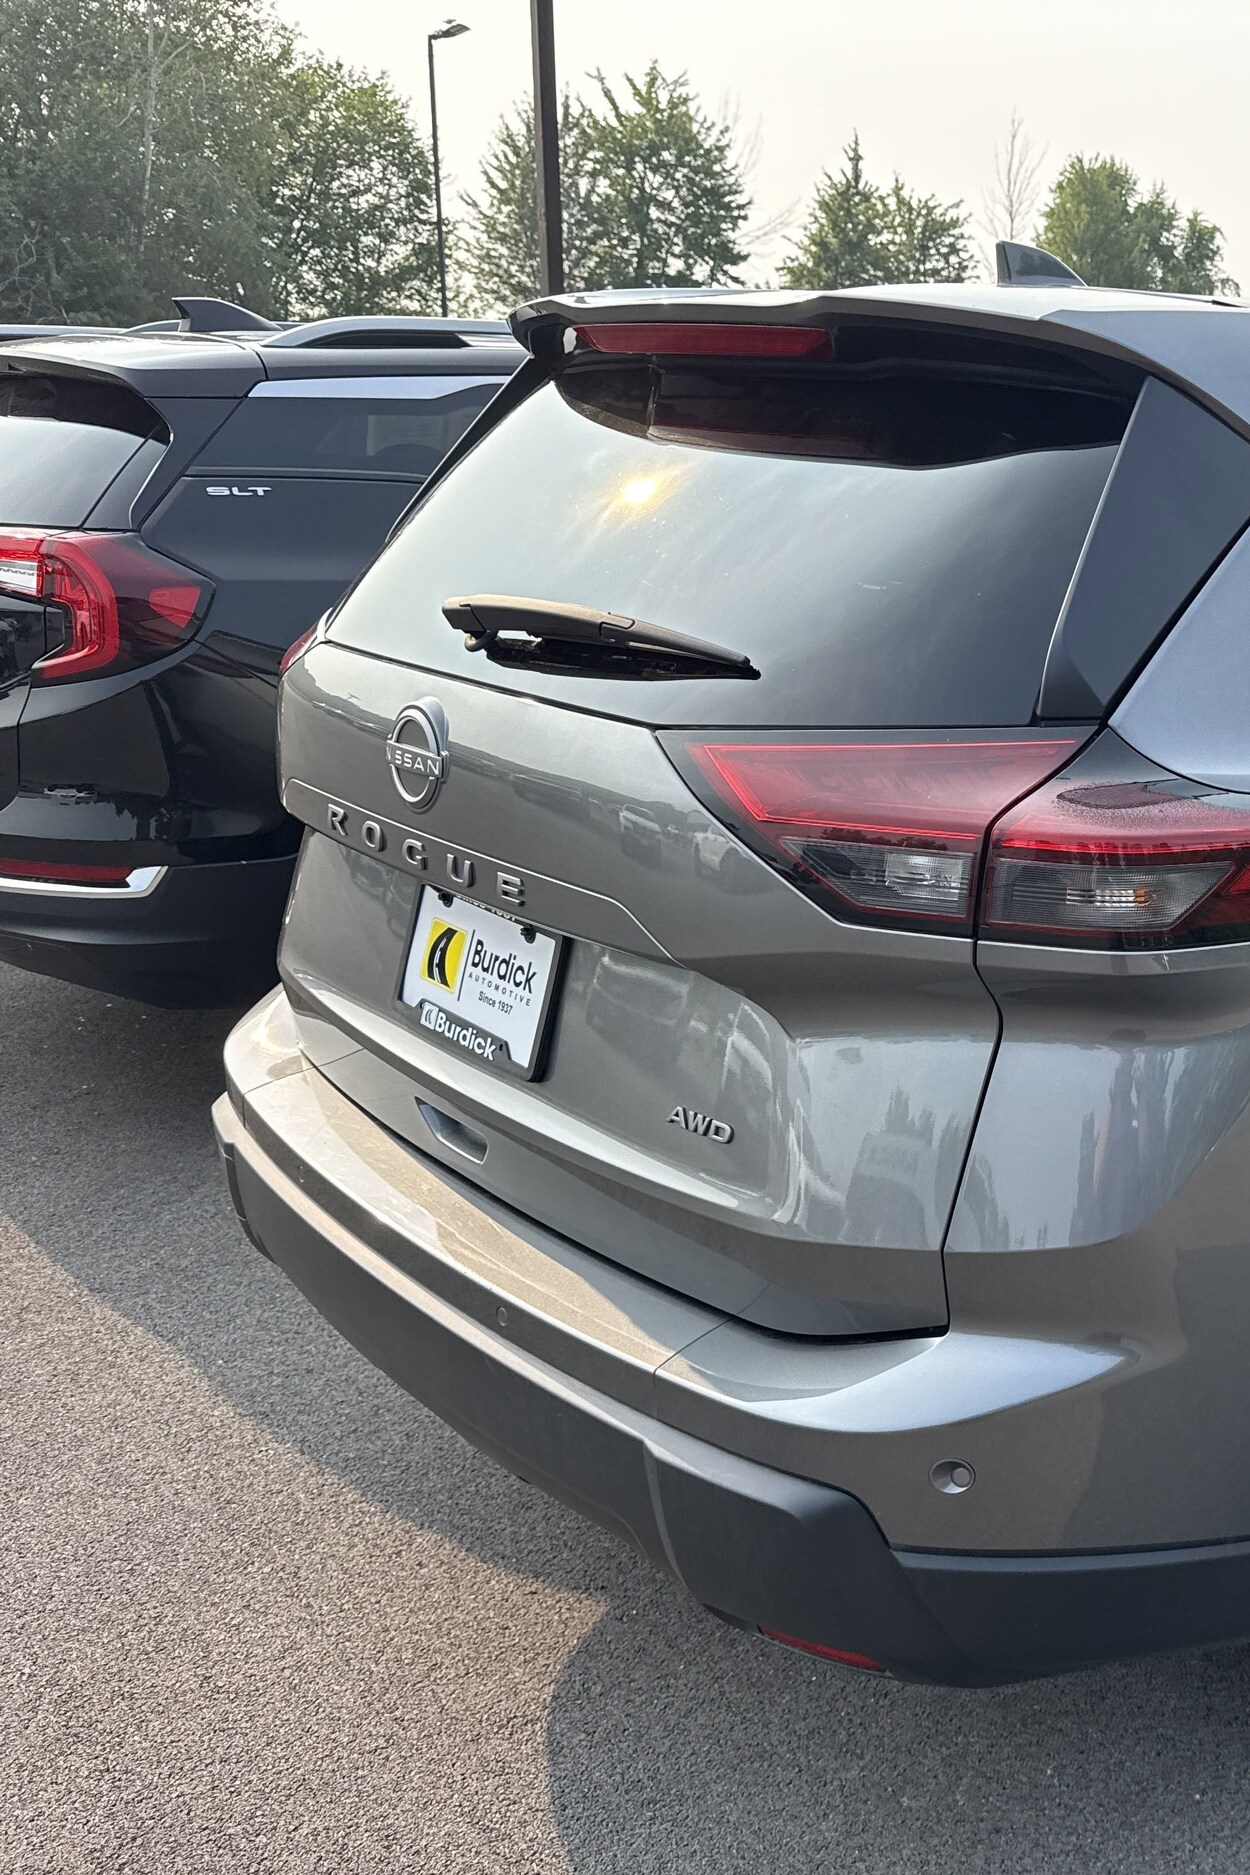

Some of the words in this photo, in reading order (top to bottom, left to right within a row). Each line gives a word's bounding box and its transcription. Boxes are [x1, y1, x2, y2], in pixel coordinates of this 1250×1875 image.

[205, 486, 273, 496] SLT
[385, 745, 440, 776] NSSAN
[328, 803, 525, 907] ROGUE
[471, 938, 538, 994] Burdick
[467, 971, 532, 1007] AUTOMOTIVE
[478, 990, 497, 1008] Since
[498, 1000, 514, 1016] 1937
[435, 1011, 497, 1062] Burdick
[666, 1106, 735, 1145] AWD
